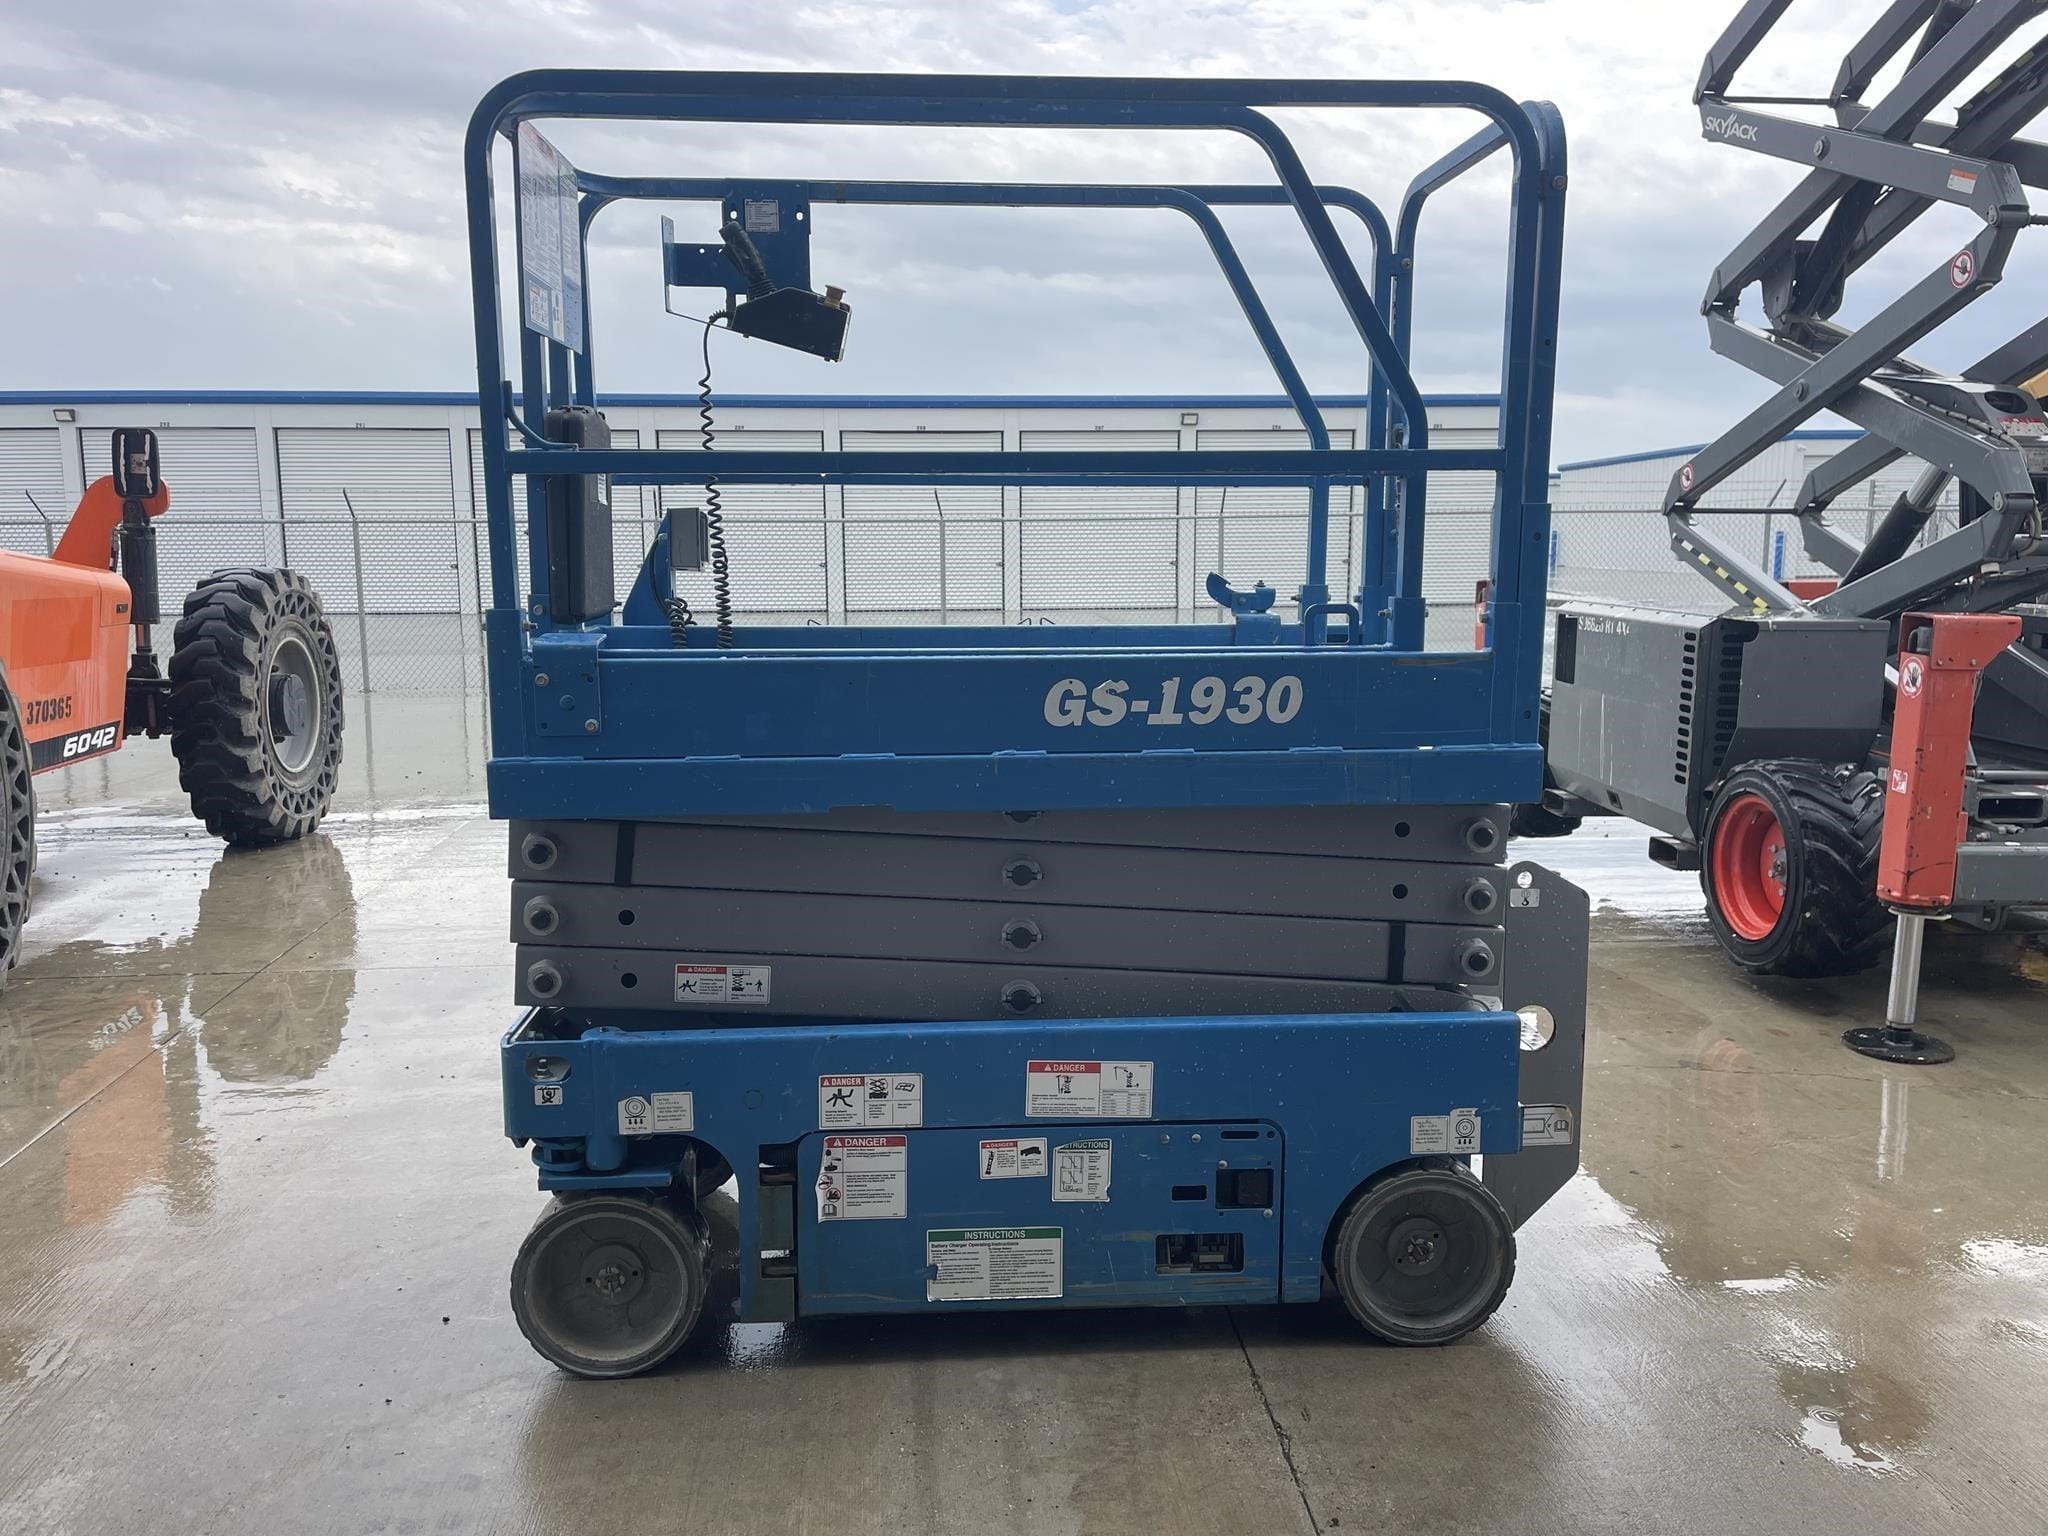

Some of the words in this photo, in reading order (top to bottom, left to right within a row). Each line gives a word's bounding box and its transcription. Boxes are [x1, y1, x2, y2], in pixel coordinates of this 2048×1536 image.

[1704, 112, 1758, 142] SKYJACK
[26, 696, 72, 725] 370365
[1044, 675, 1304, 727] GS-1930
[63, 726, 116, 757] 6042
[1053, 1063, 1086, 1072] DANGER
[831, 1078, 861, 1086] DANGER
[844, 1138, 887, 1147] DANGER
[964, 1230, 1026, 1240] INSTRUCTIONS
